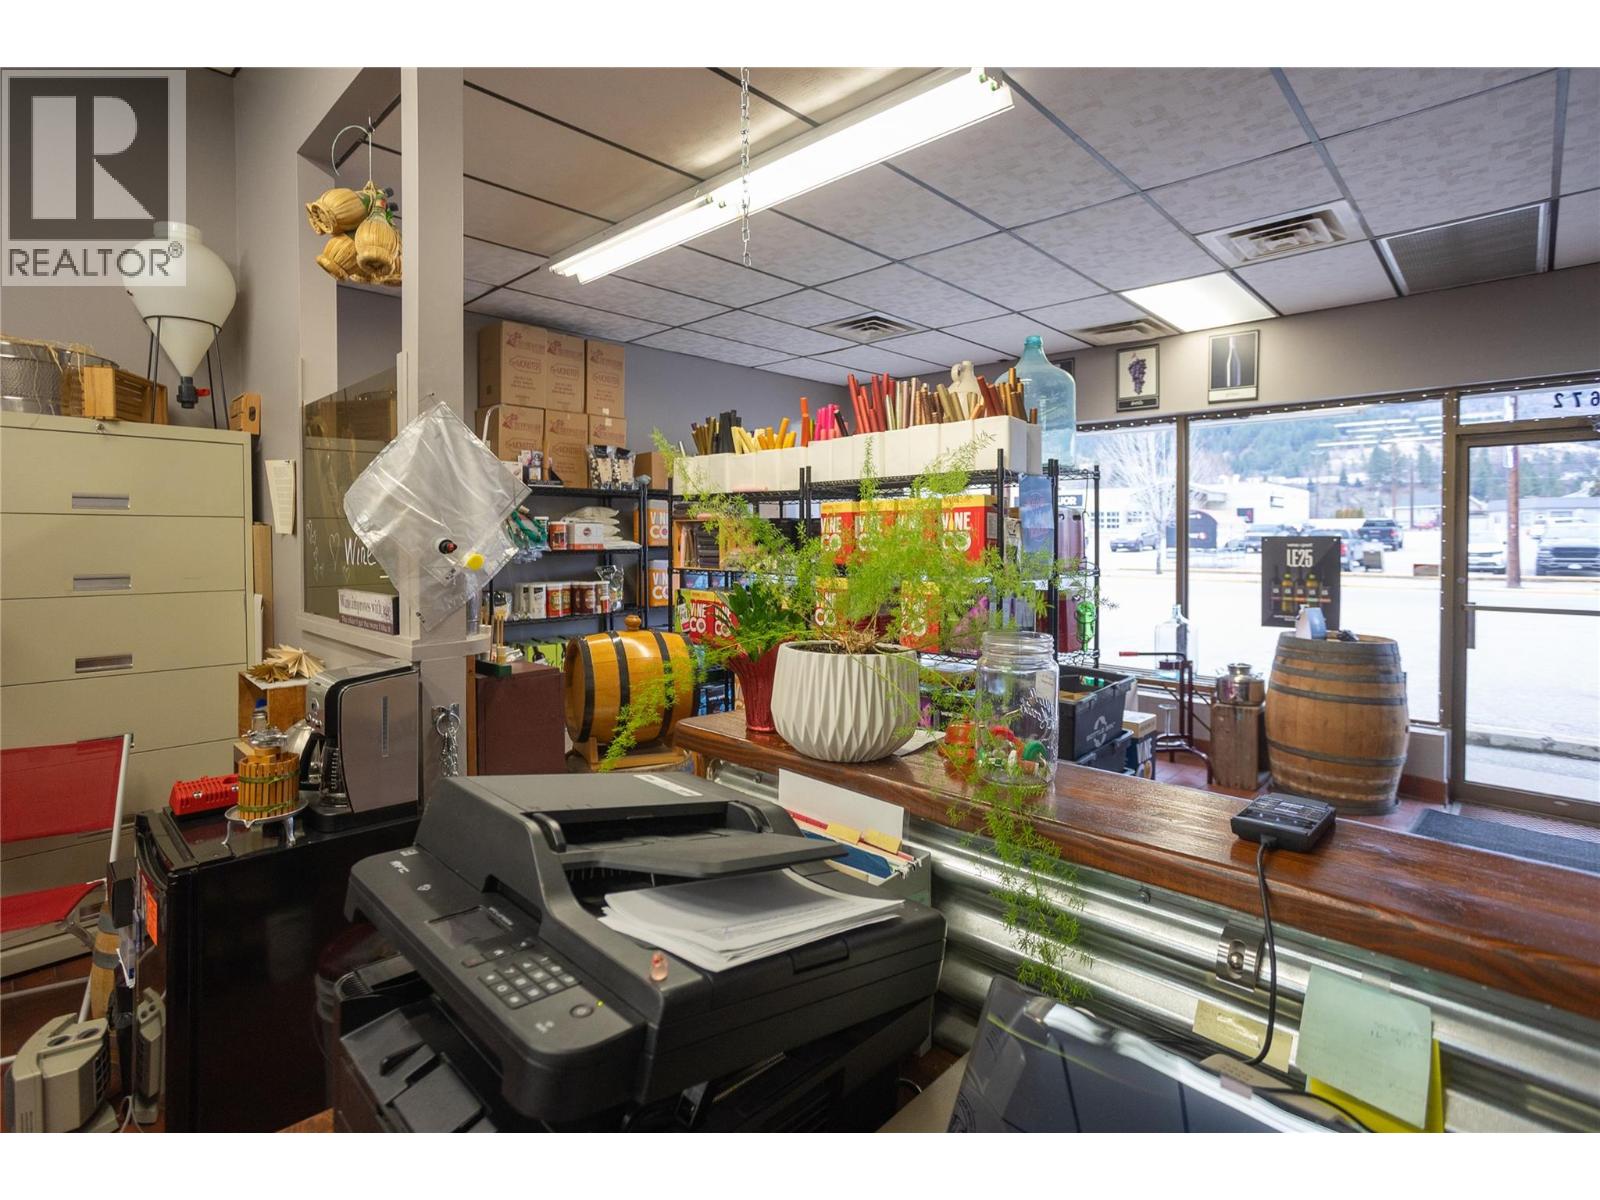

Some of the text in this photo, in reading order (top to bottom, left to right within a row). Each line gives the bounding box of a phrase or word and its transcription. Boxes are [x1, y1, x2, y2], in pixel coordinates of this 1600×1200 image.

[344, 535, 377, 566] Wine
[1286, 548, 1313, 568] LE25
[690, 617, 707, 634] CO
